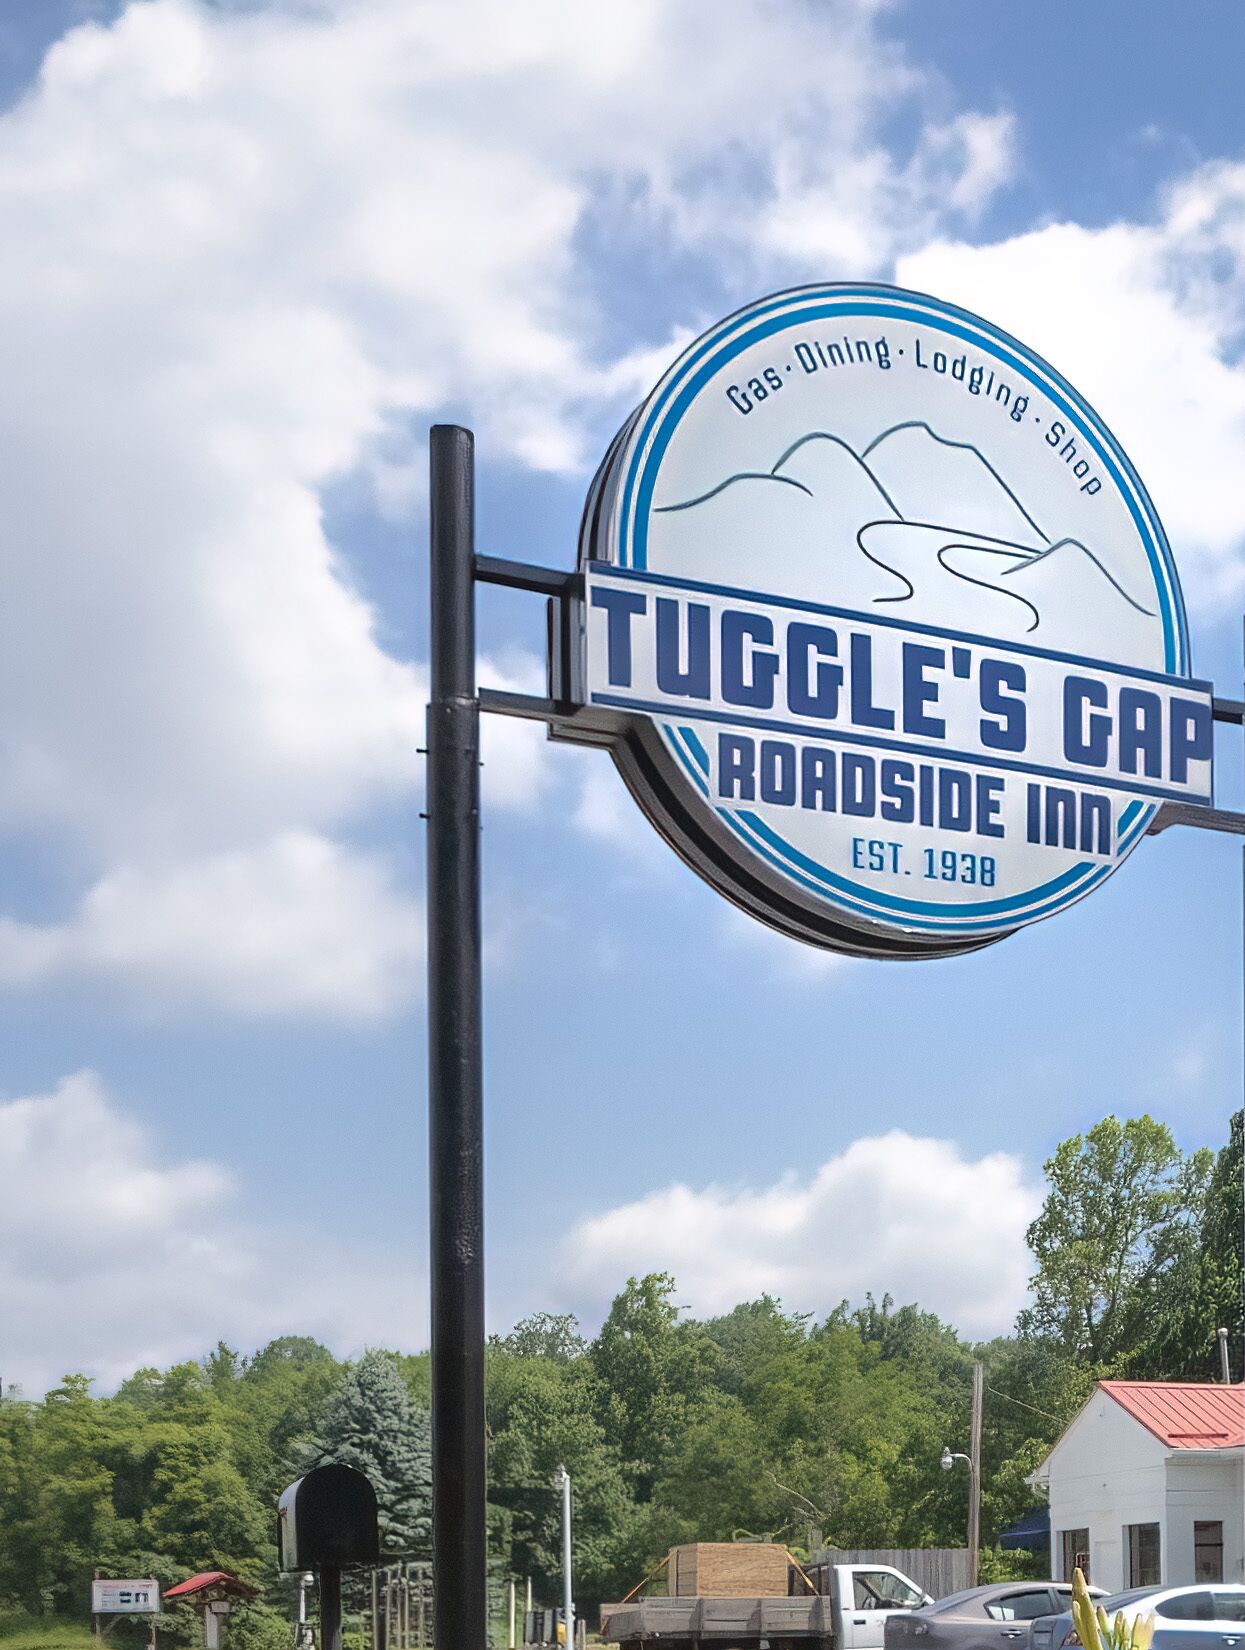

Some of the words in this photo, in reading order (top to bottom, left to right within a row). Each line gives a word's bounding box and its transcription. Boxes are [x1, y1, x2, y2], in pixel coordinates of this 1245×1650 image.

[725, 366, 783, 415] Gas
[794, 336, 893, 374] Dining
[914, 340, 1029, 422] Lodging
[1045, 421, 1102, 496] Shop
[591, 586, 1028, 753] TUGGLE'S
[1062, 675, 1212, 784] GAP
[717, 733, 1006, 838] ROADSIDE
[1026, 783, 1112, 856] INN
[852, 838, 911, 876] EST.
[923, 848, 996, 887] 1938
